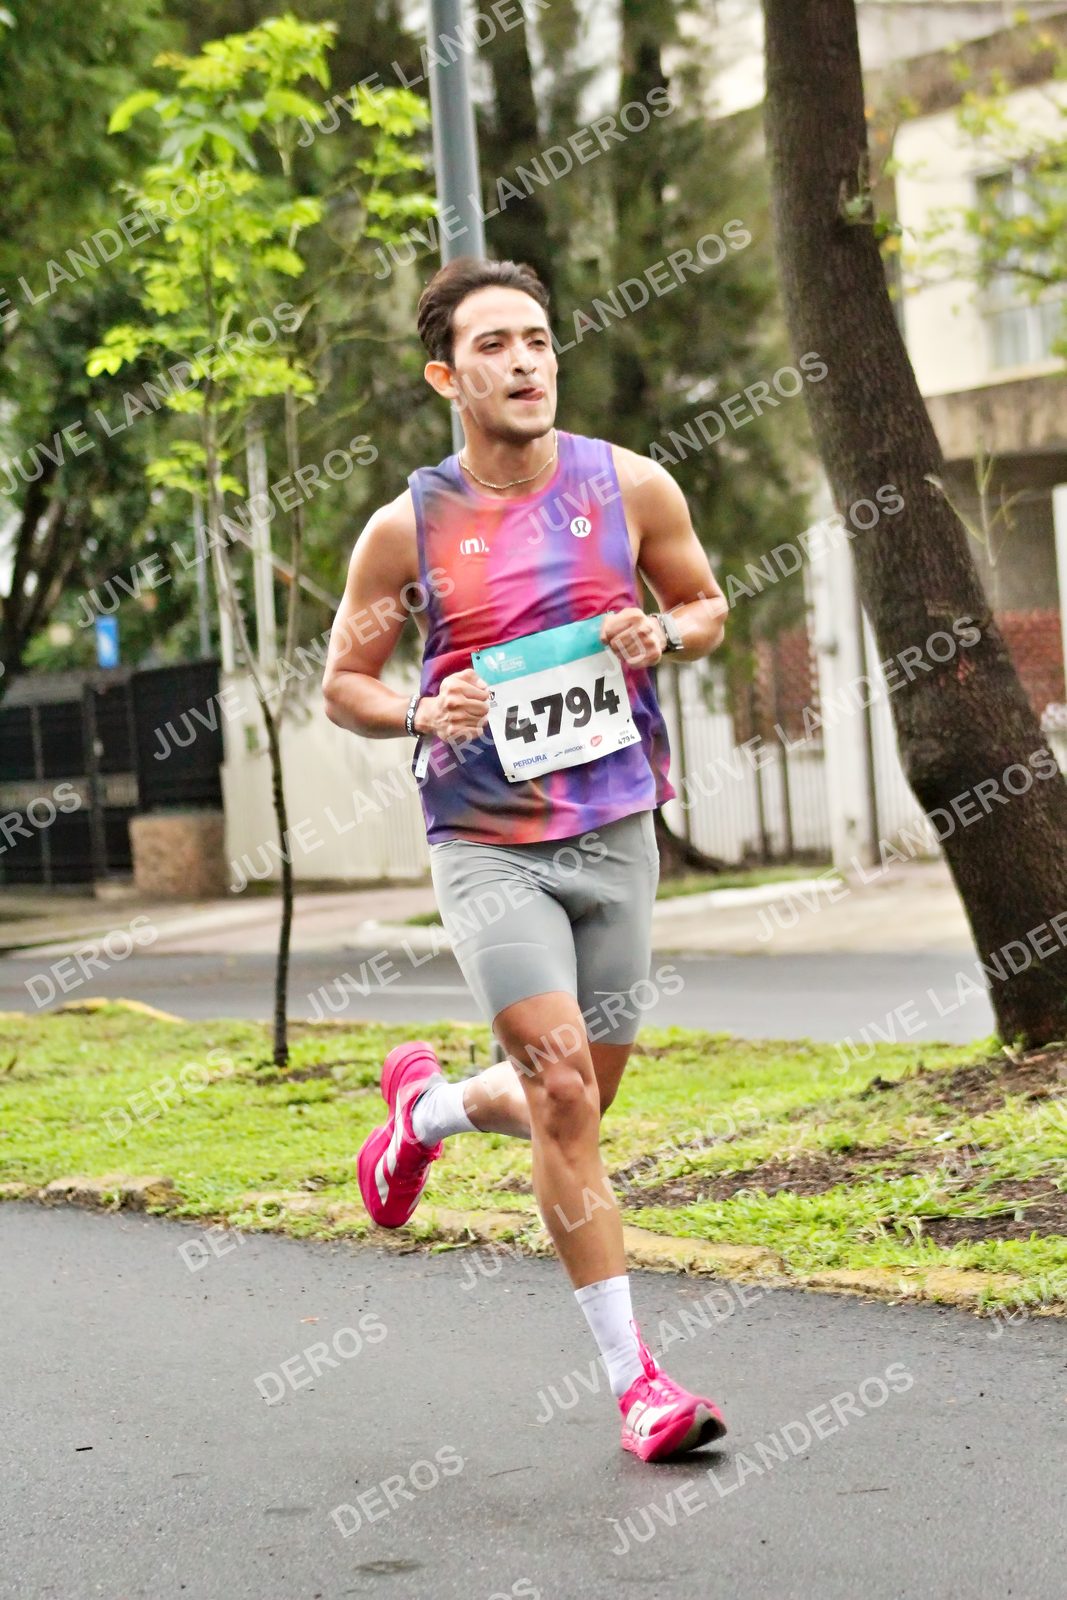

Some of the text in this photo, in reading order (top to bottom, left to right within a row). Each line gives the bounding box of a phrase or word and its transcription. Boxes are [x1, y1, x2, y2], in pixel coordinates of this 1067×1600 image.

[505, 676, 620, 743] 4794
[618, 734, 635, 745] 4794
[513, 753, 548, 769] PERDURA
